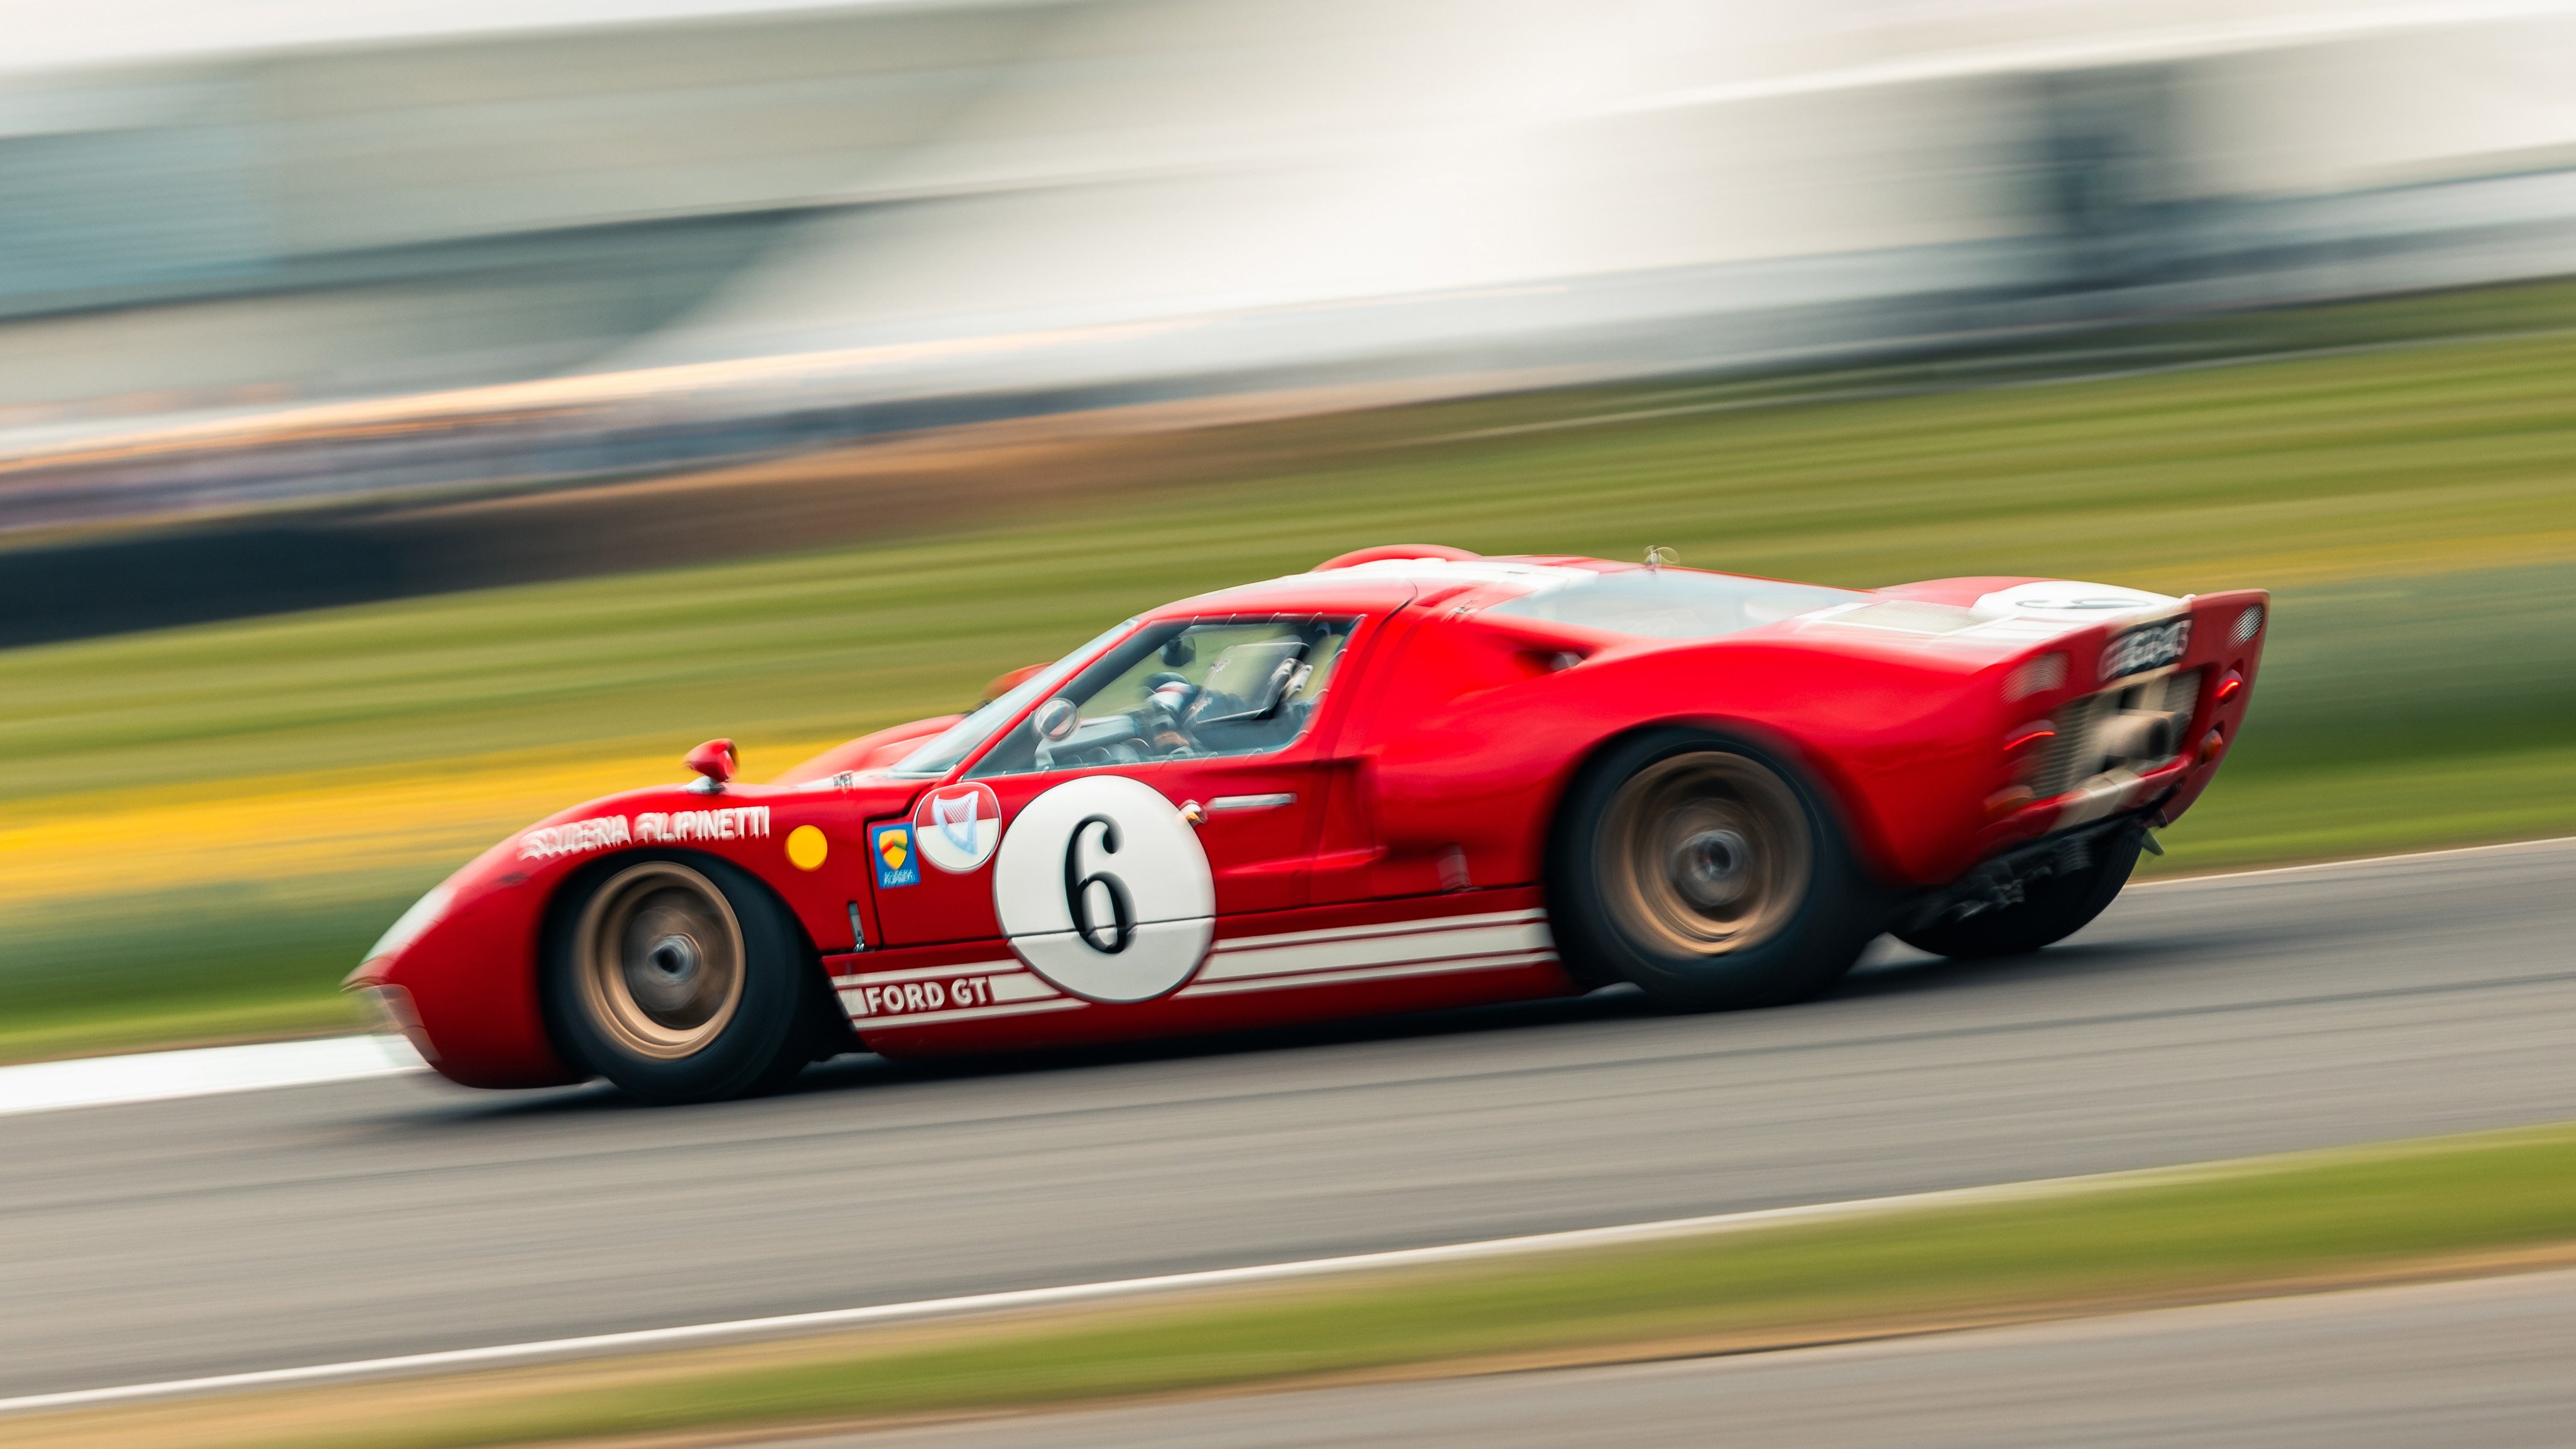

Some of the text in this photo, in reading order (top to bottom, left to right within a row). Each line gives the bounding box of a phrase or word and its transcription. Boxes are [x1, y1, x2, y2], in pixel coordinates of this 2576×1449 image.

[1063, 812, 1137, 955] 6
[866, 977, 987, 1016] FORD GT
